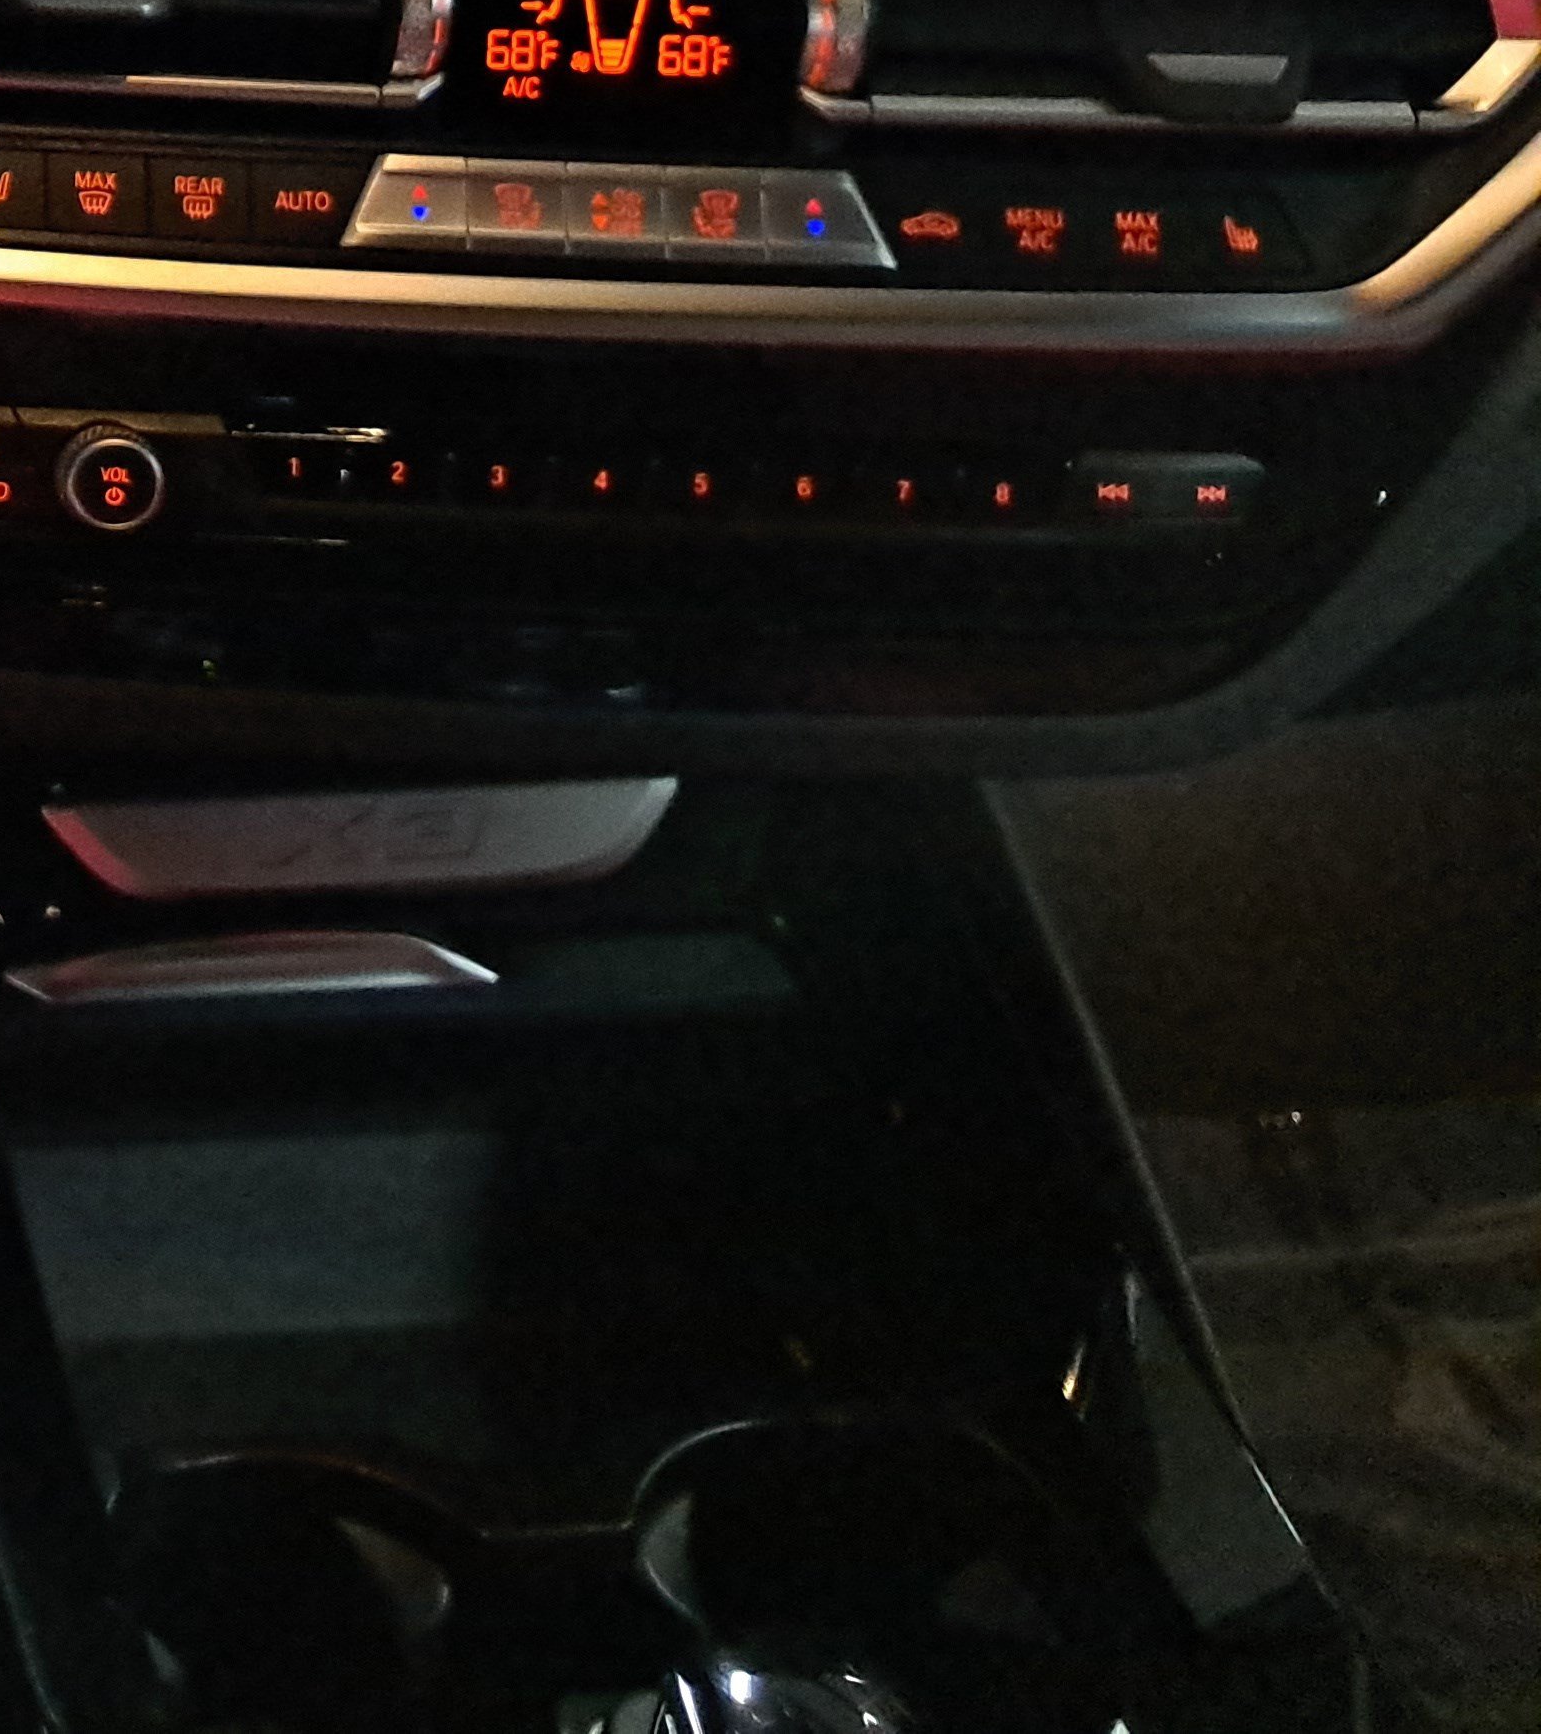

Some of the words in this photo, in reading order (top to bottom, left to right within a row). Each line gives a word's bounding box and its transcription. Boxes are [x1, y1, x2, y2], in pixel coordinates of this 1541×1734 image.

[503, 76, 541, 99] A/C
[74, 170, 116, 191] MAX
[174, 175, 224, 196] REAR
[275, 191, 333, 213] AUTO
[1005, 207, 1064, 229] MENU
[1115, 211, 1158, 230] MAX
[1019, 230, 1054, 251] A/C
[1122, 232, 1158, 253] A/C
[100, 467, 130, 483] VOL
[289, 457, 301, 477] 1
[391, 461, 406, 483] 2
[490, 465, 506, 488] 3
[593, 470, 610, 491] 4
[694, 473, 708, 495] 5
[797, 476, 812, 498] 6
[897, 480, 911, 500] 7
[995, 482, 1011, 504] 8
